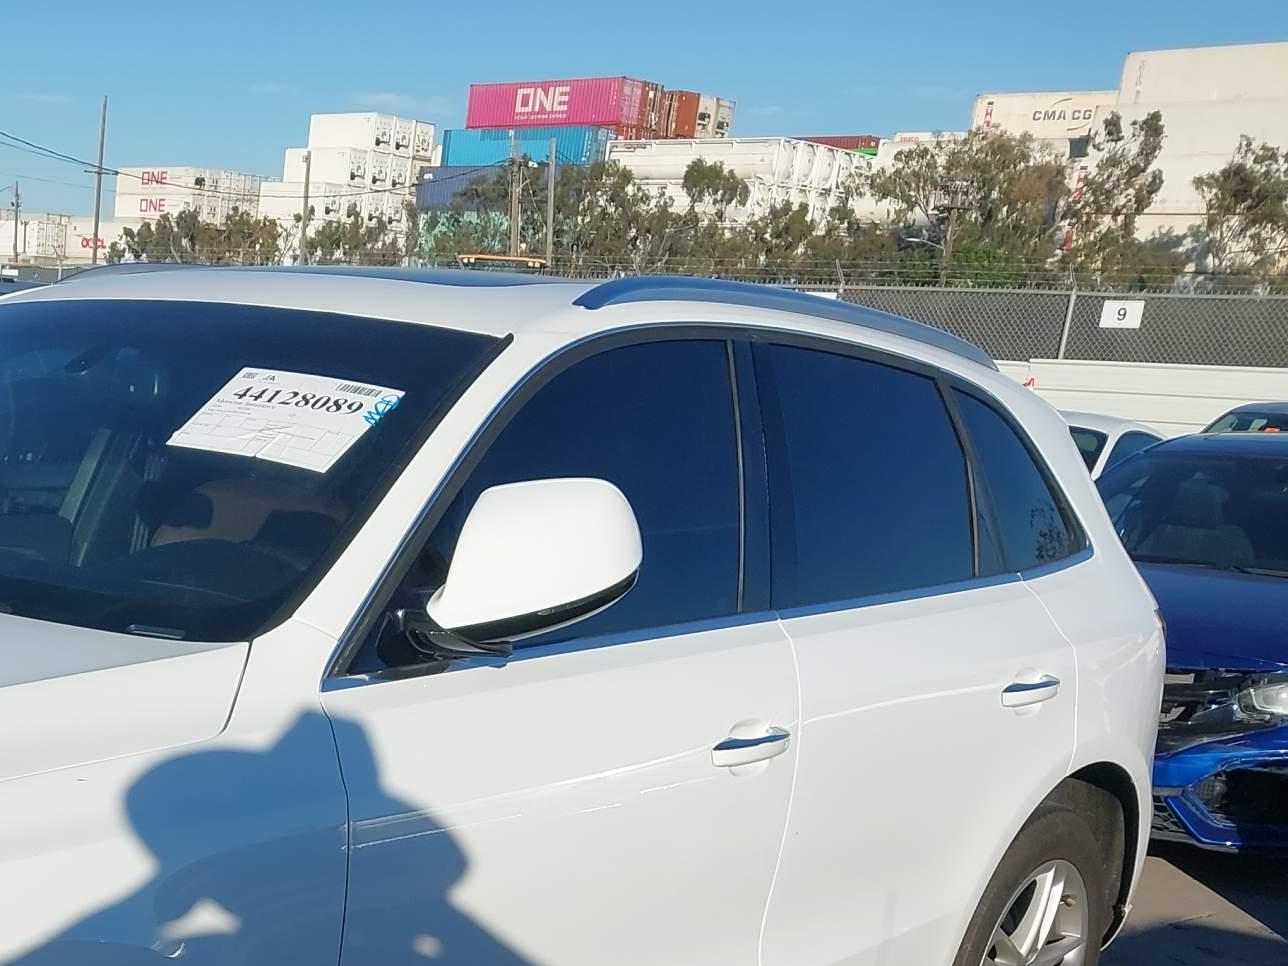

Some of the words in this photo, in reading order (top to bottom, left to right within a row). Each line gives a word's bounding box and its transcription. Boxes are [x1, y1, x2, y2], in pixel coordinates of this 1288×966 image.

[515, 86, 570, 112] ONE
[1032, 110, 1066, 121] CMA
[141, 171, 168, 185] ONE
[140, 198, 166, 212] ONE
[1116, 307, 1128, 321] 9
[233, 385, 364, 415] 44128089
